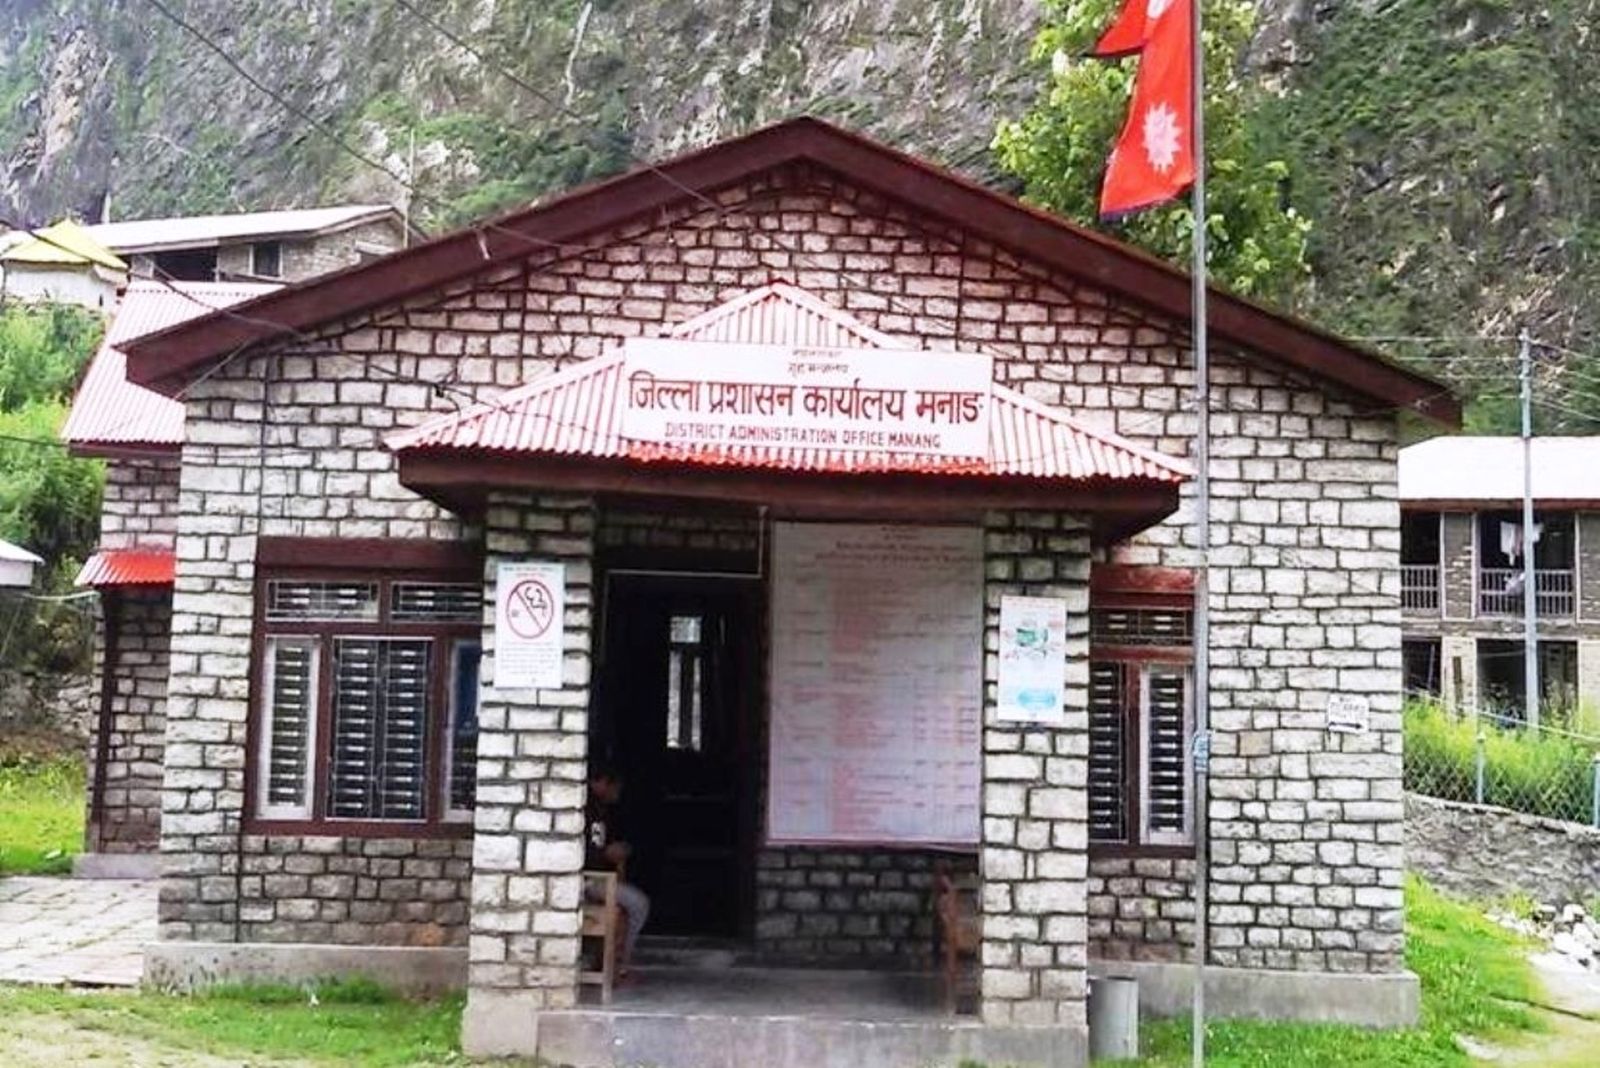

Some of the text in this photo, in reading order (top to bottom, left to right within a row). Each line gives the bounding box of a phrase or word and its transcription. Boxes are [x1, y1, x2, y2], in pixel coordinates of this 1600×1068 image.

[628, 370, 702, 412] जिल्ला
[706, 381, 797, 416] प्रशासन
[802, 378, 906, 421] कार्यालय
[665, 422, 941, 448] DISTRICT ADMINISTRATION OFFICE MANANG
